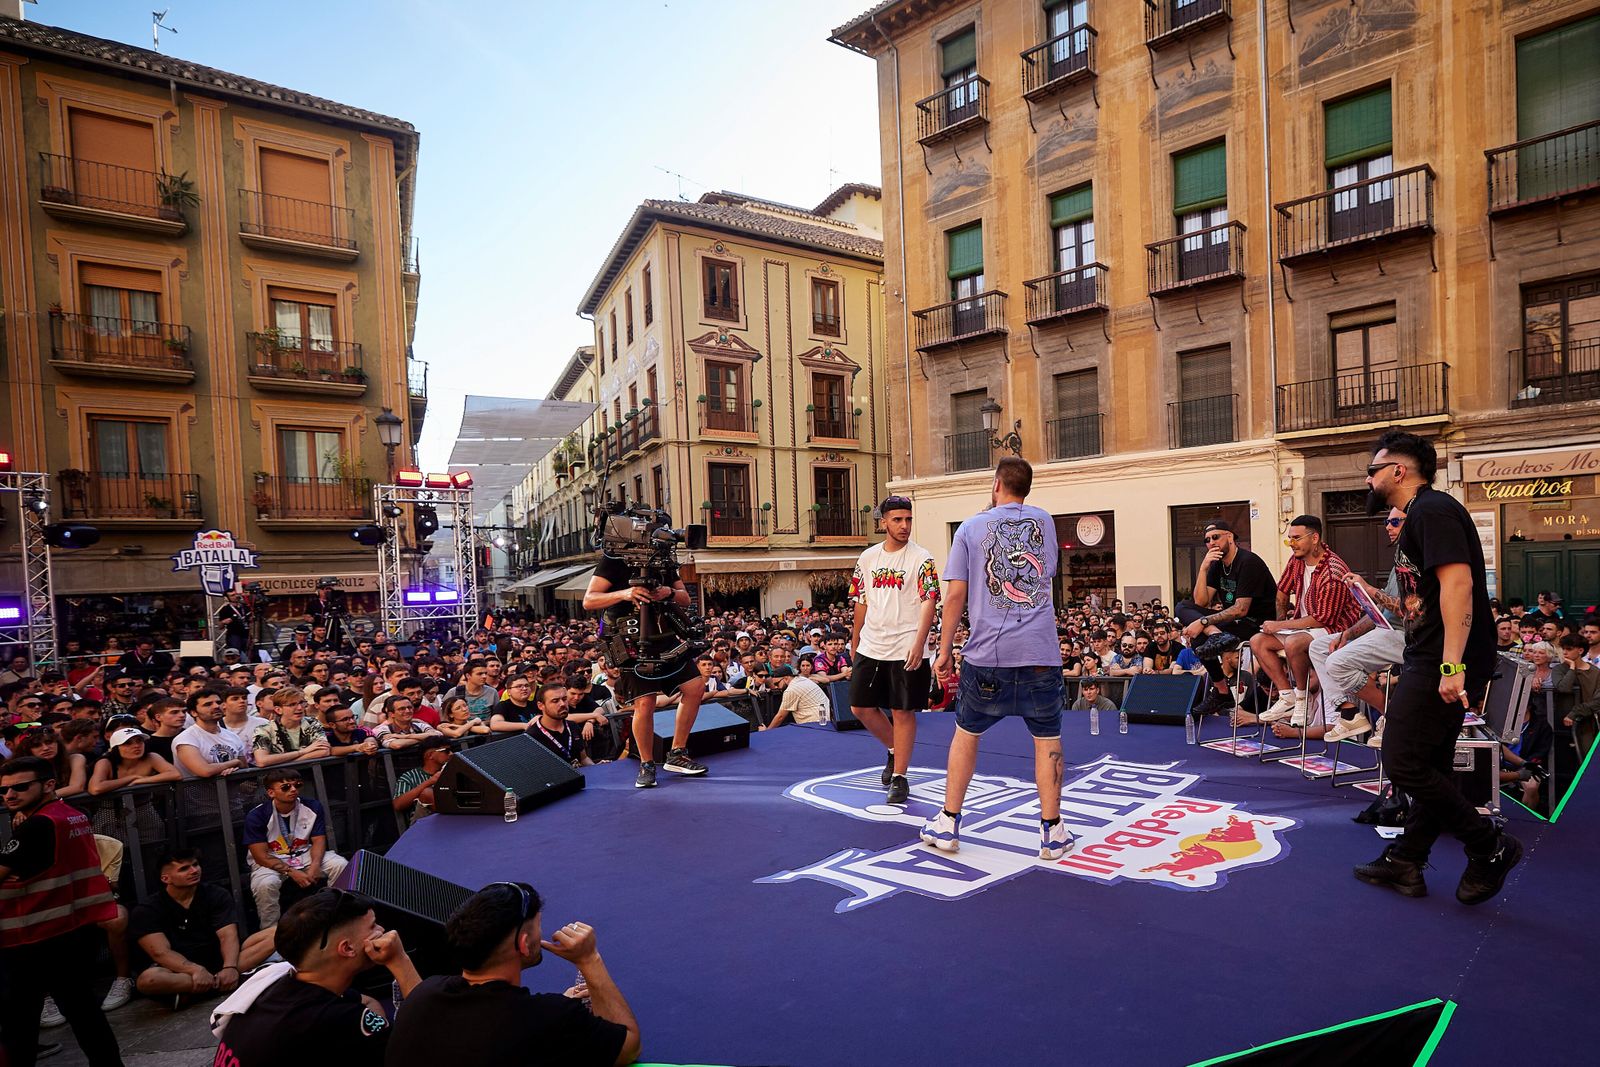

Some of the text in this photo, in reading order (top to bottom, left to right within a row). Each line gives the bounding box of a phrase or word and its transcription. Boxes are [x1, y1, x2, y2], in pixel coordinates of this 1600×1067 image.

[1476, 451, 1600, 478] Cuadros Mo
[1482, 478, 1574, 500] Cuadros
[1543, 514, 1589, 526] MORA
[196, 541, 214, 549] Red
[183, 549, 248, 565] BATALLA
[337, 577, 365, 588] RUIZ
[1057, 799, 1223, 875] Red Bull
